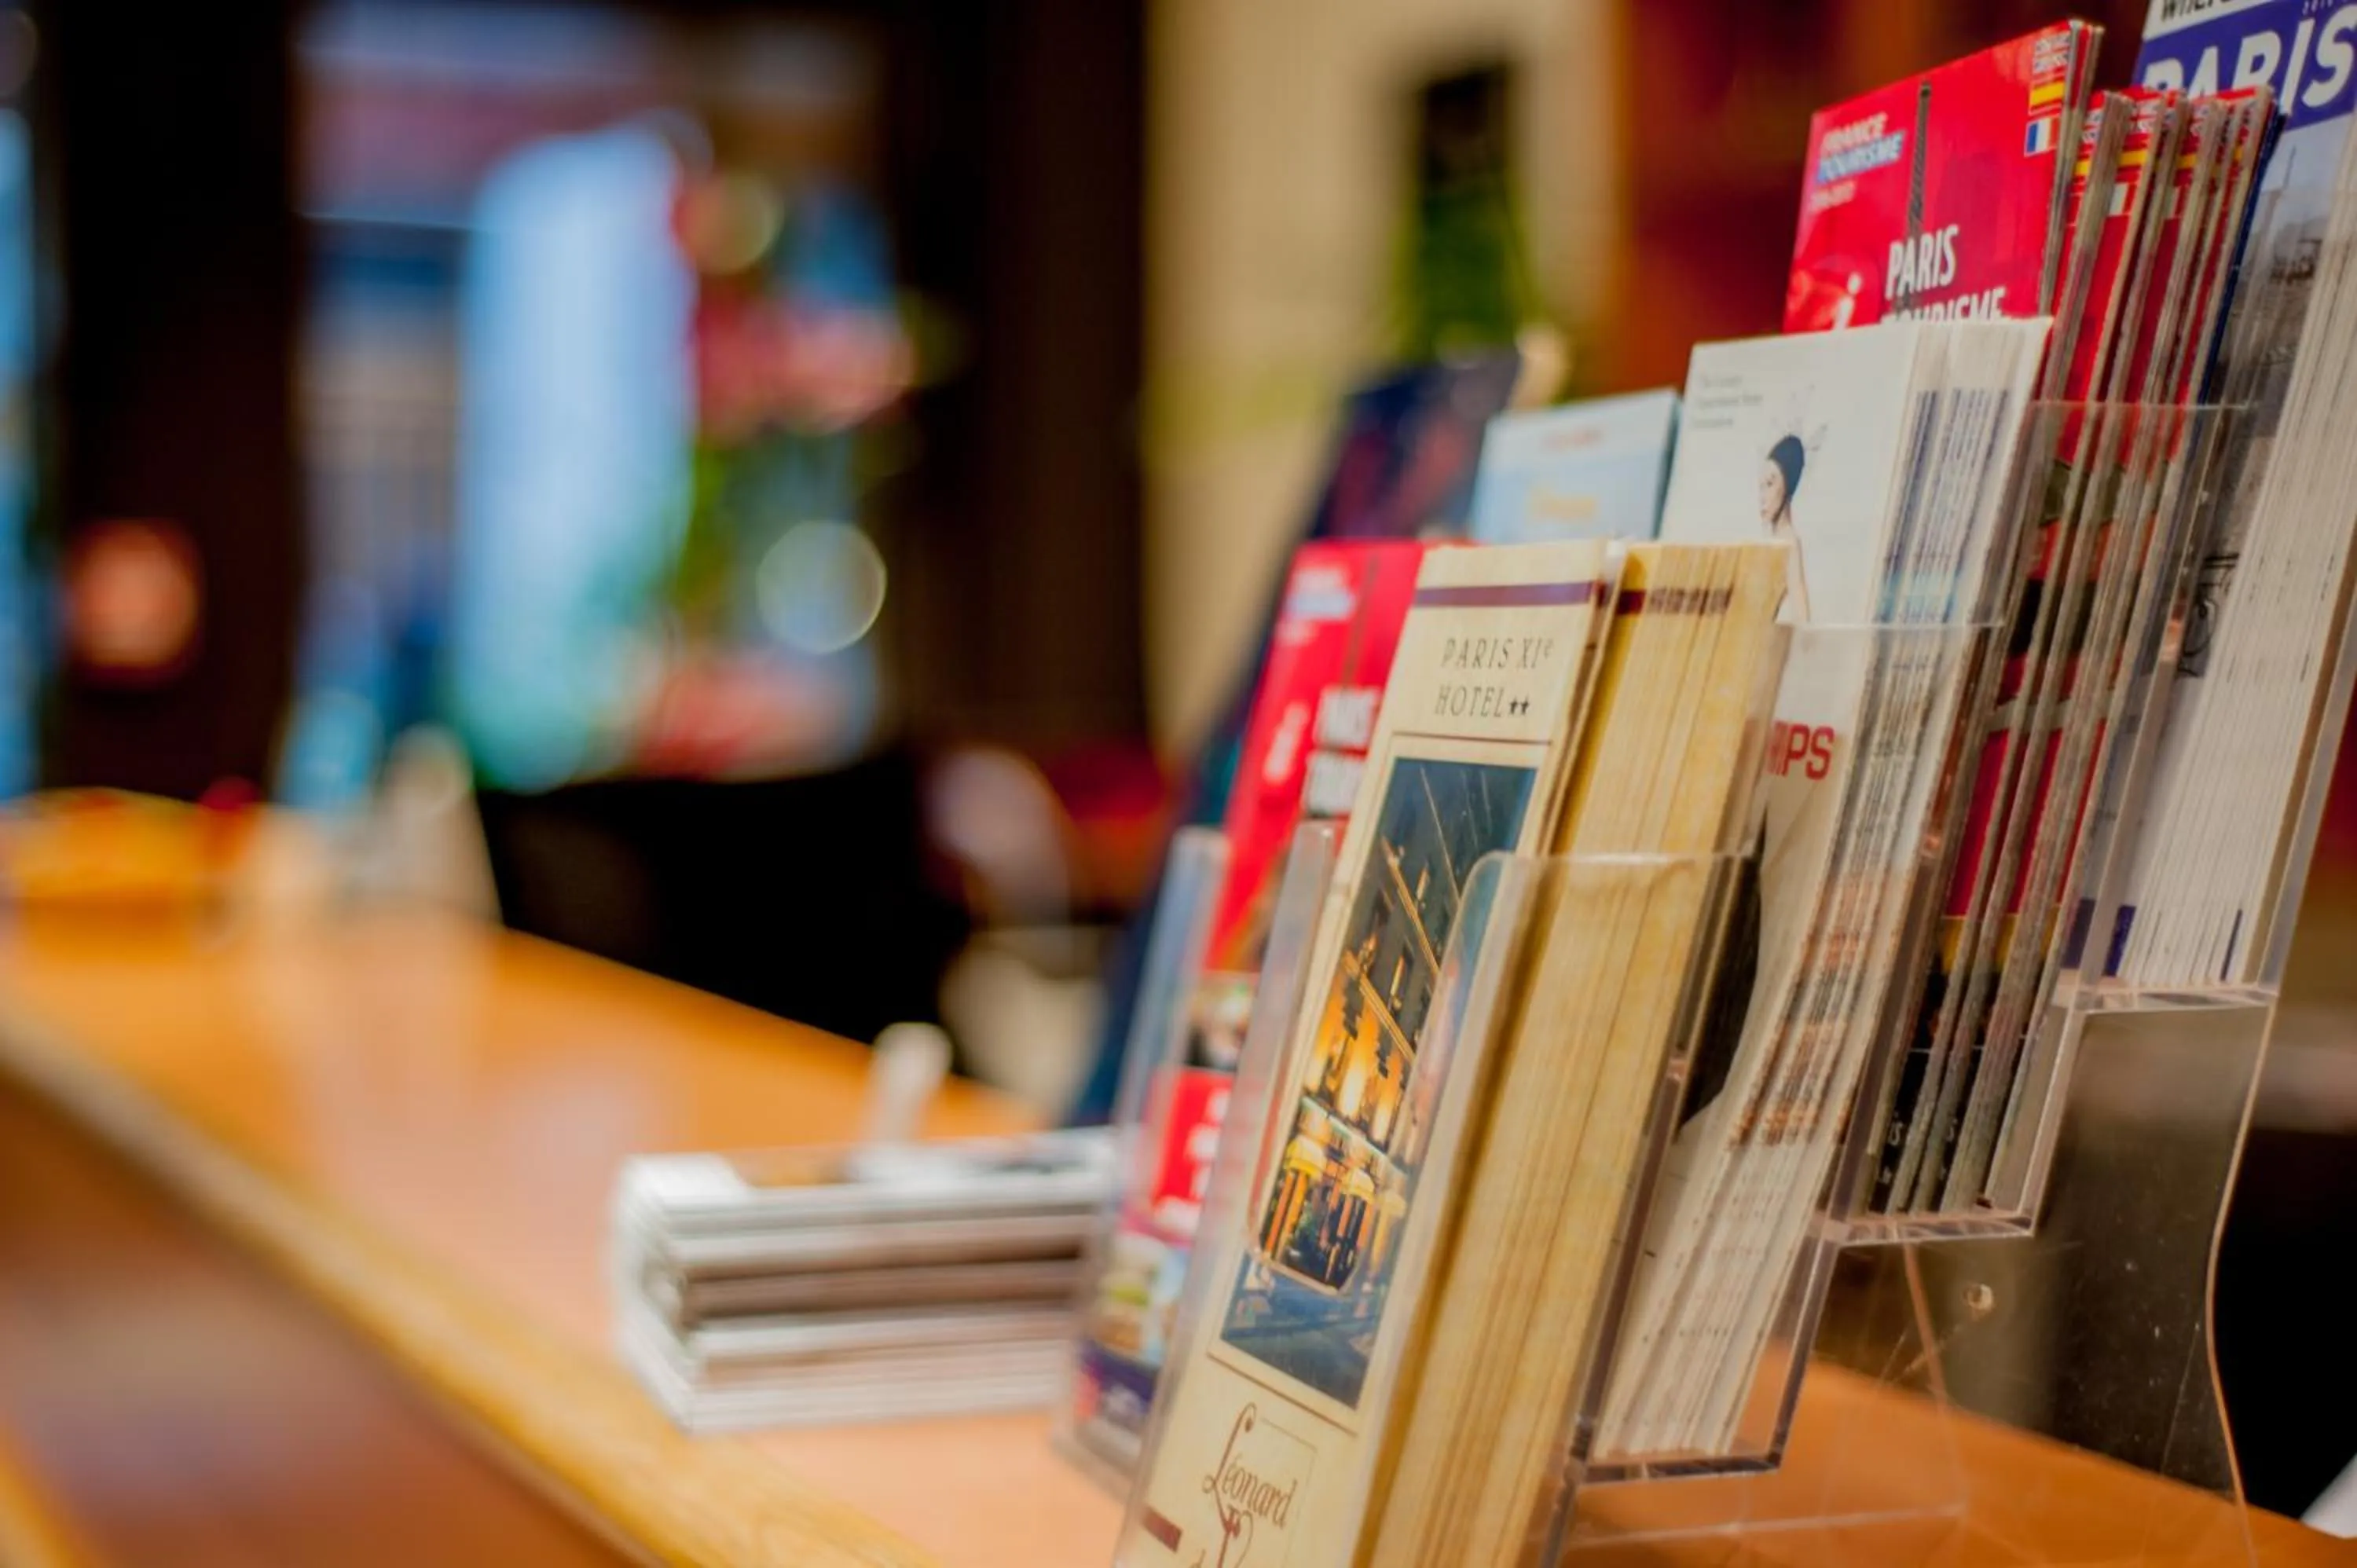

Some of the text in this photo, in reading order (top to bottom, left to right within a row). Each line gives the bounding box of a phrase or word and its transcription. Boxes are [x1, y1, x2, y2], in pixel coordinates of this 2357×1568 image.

[2141, 4, 2357, 116] PARIS
[1885, 224, 1959, 300] PARIS
[1441, 637, 1513, 669] PARIS
[1434, 684, 1505, 718] HOTEL
